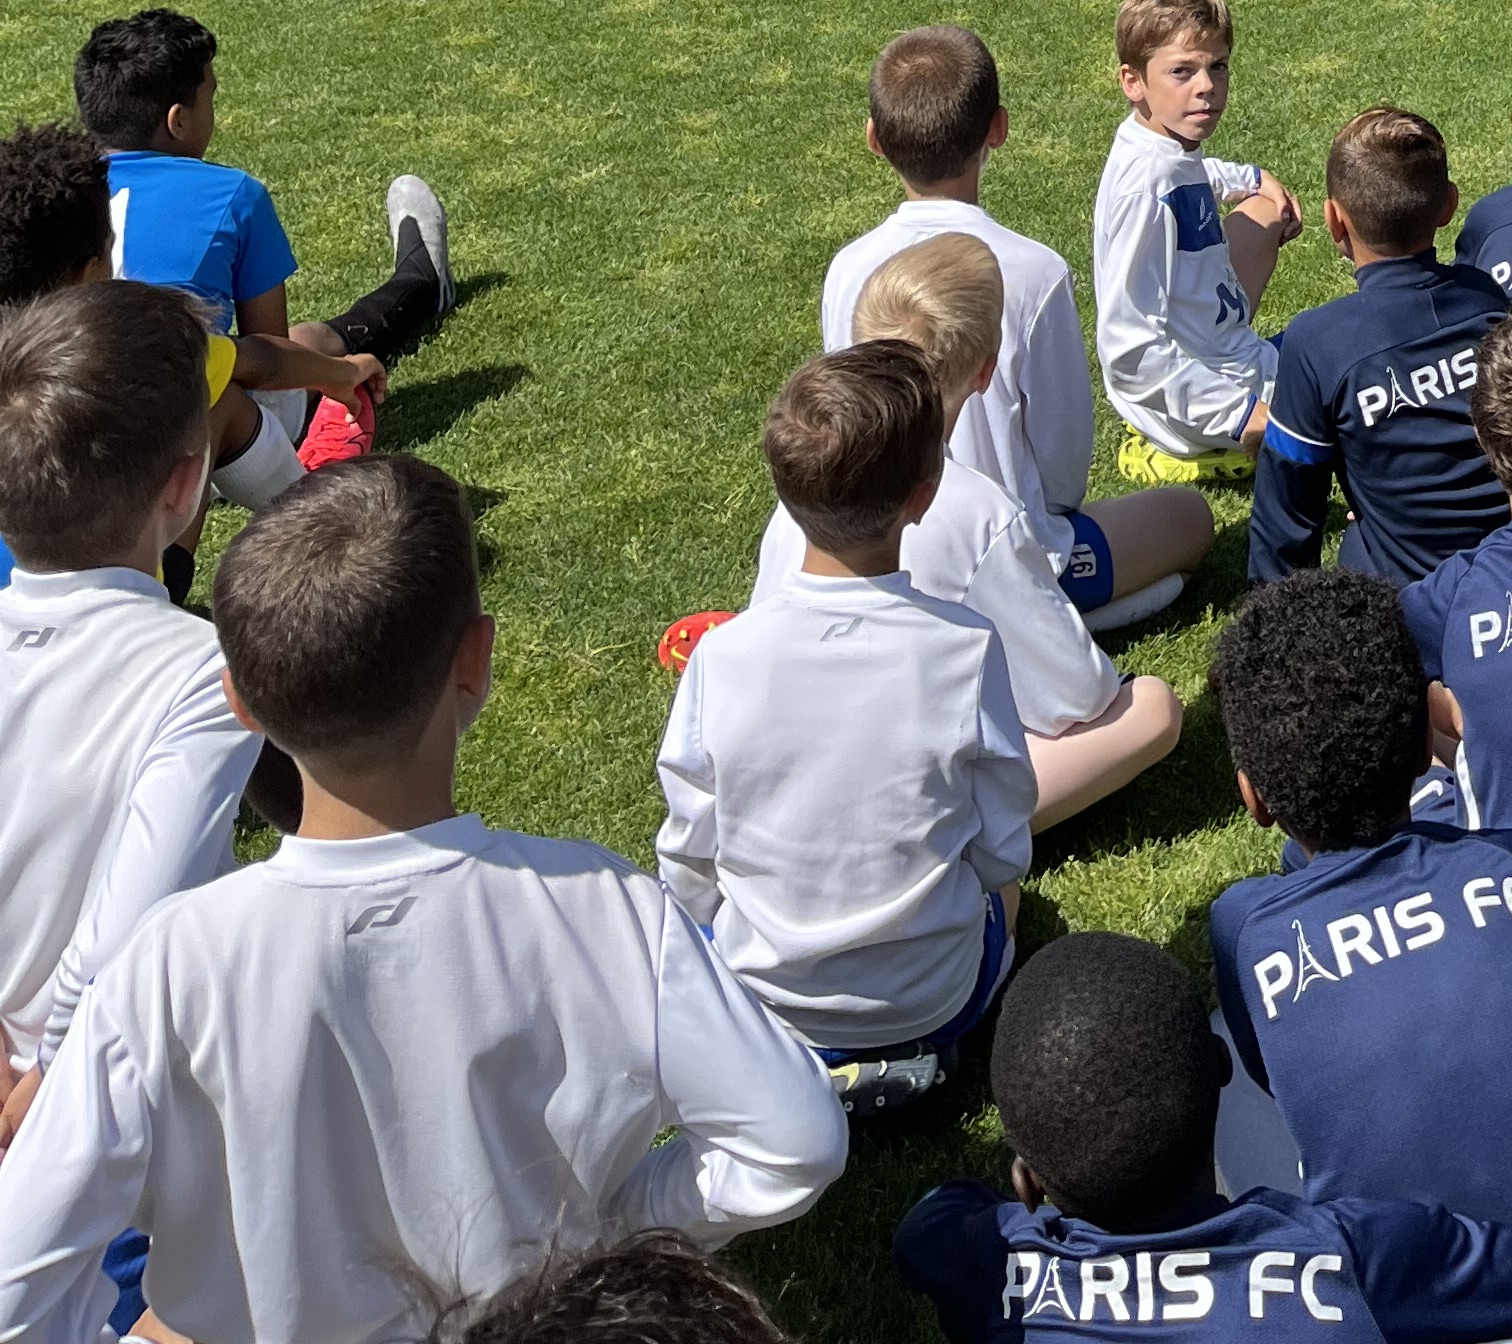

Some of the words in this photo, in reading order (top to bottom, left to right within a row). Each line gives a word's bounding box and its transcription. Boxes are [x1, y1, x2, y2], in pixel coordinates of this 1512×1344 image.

[1356, 348, 1479, 428] PARIS
[1071, 550, 1094, 574] 91
[1253, 892, 1445, 1020] PARIS
[1002, 1251, 1215, 1322] PARIS
[1249, 1251, 1344, 1322] FC
